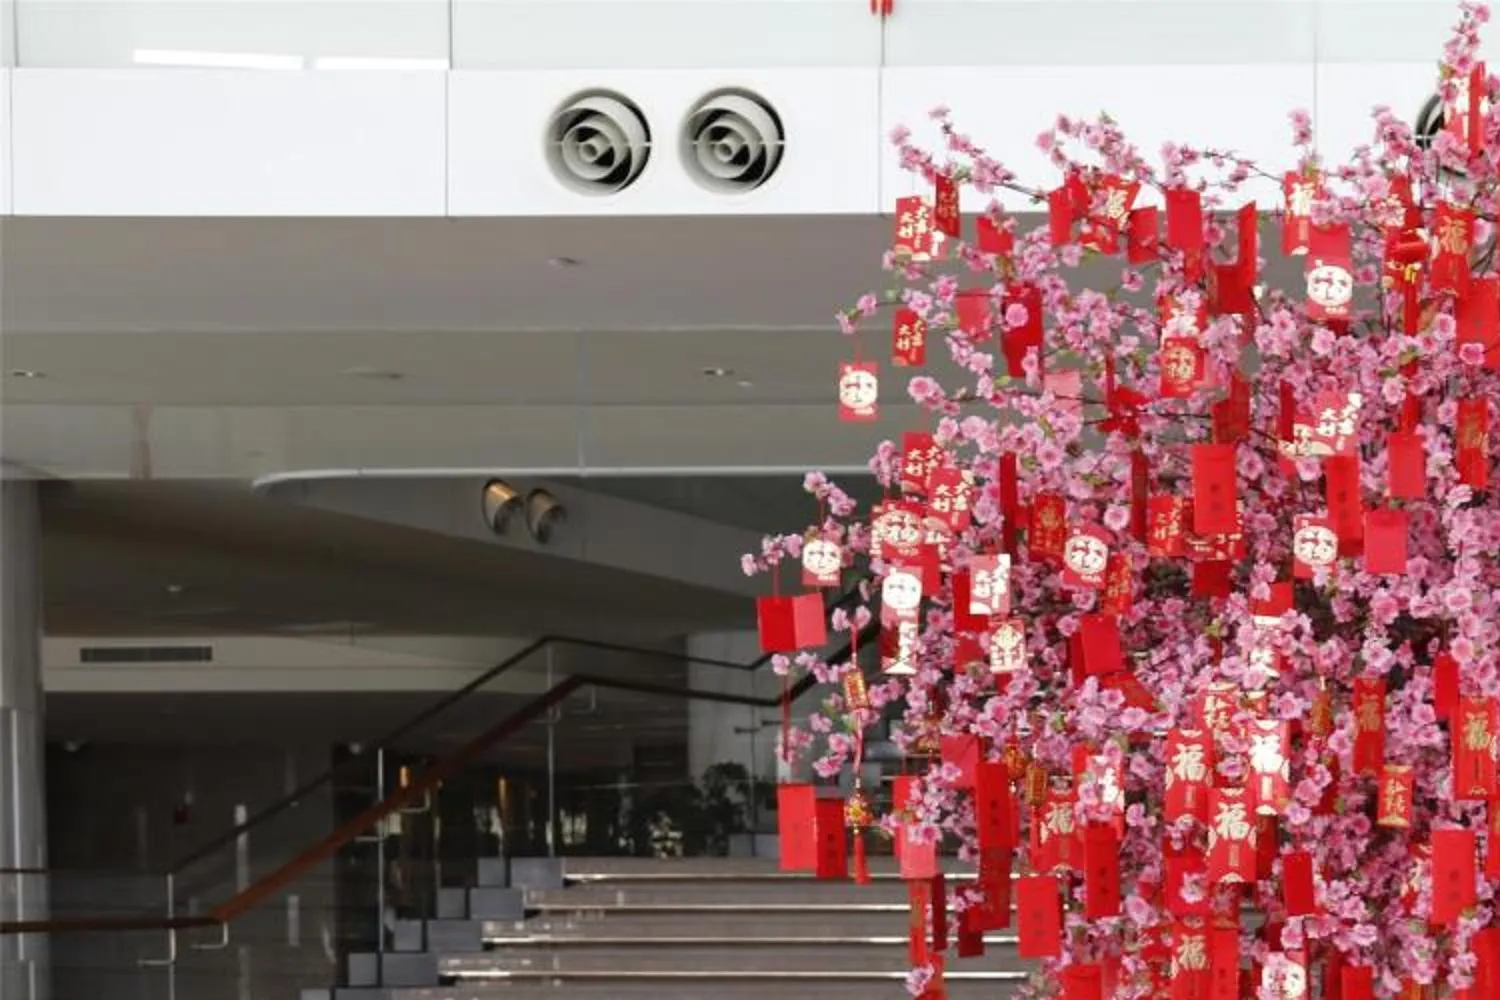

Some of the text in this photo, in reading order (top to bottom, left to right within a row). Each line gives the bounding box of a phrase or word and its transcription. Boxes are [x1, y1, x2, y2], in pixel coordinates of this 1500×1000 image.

[1172, 743, 1206, 781] 福
[1213, 802, 1250, 840] 福
[1178, 935, 1206, 969] 福
